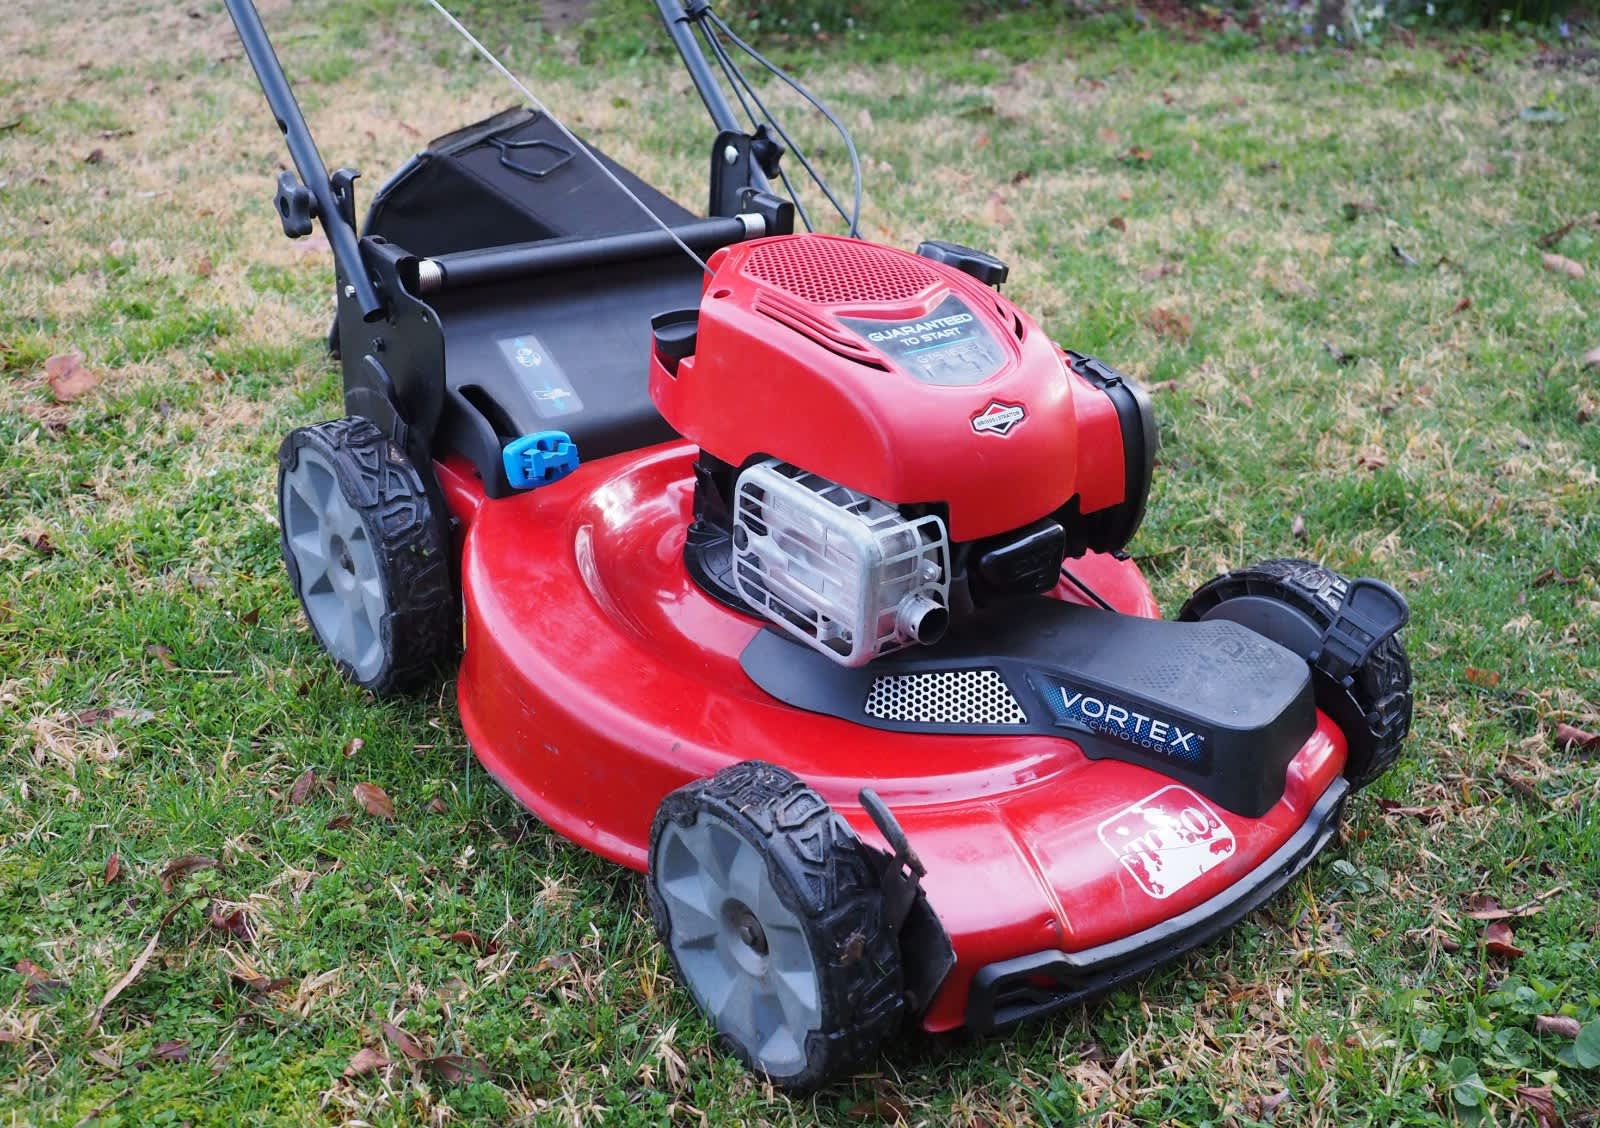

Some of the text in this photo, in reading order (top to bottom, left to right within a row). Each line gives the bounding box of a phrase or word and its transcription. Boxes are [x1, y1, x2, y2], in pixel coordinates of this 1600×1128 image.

[868, 313, 974, 342] GUARANTEED
[901, 327, 962, 347] TO START
[1060, 686, 1195, 751] VORTEX
[1072, 714, 1177, 756] TECHNOLOGY
